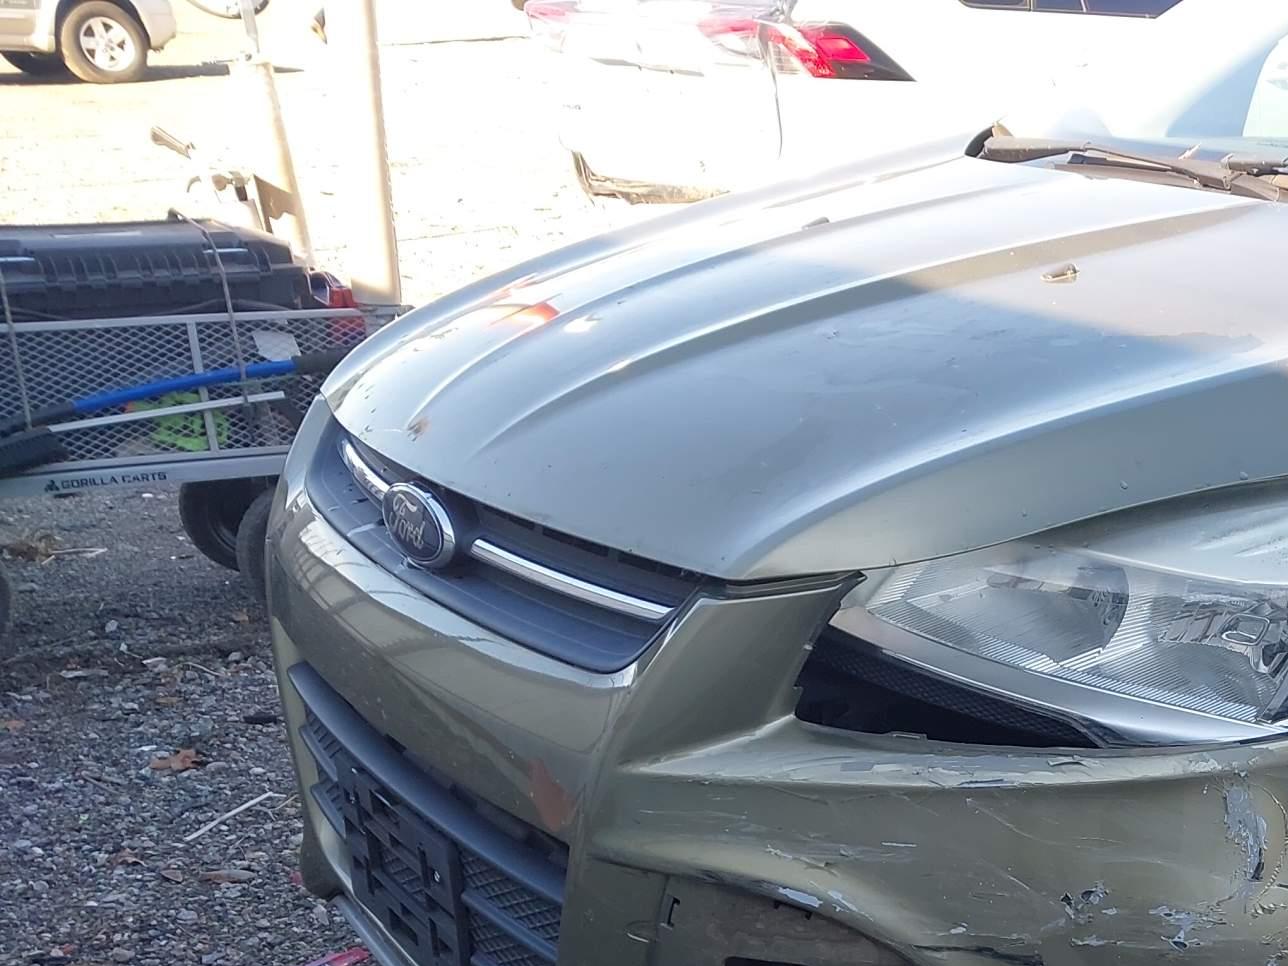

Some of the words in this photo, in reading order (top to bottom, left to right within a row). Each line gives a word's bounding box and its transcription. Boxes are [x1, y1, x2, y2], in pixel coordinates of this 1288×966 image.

[61, 475, 119, 490] GORILLA
[122, 471, 168, 484] CARTS
[389, 493, 426, 550] Ford
